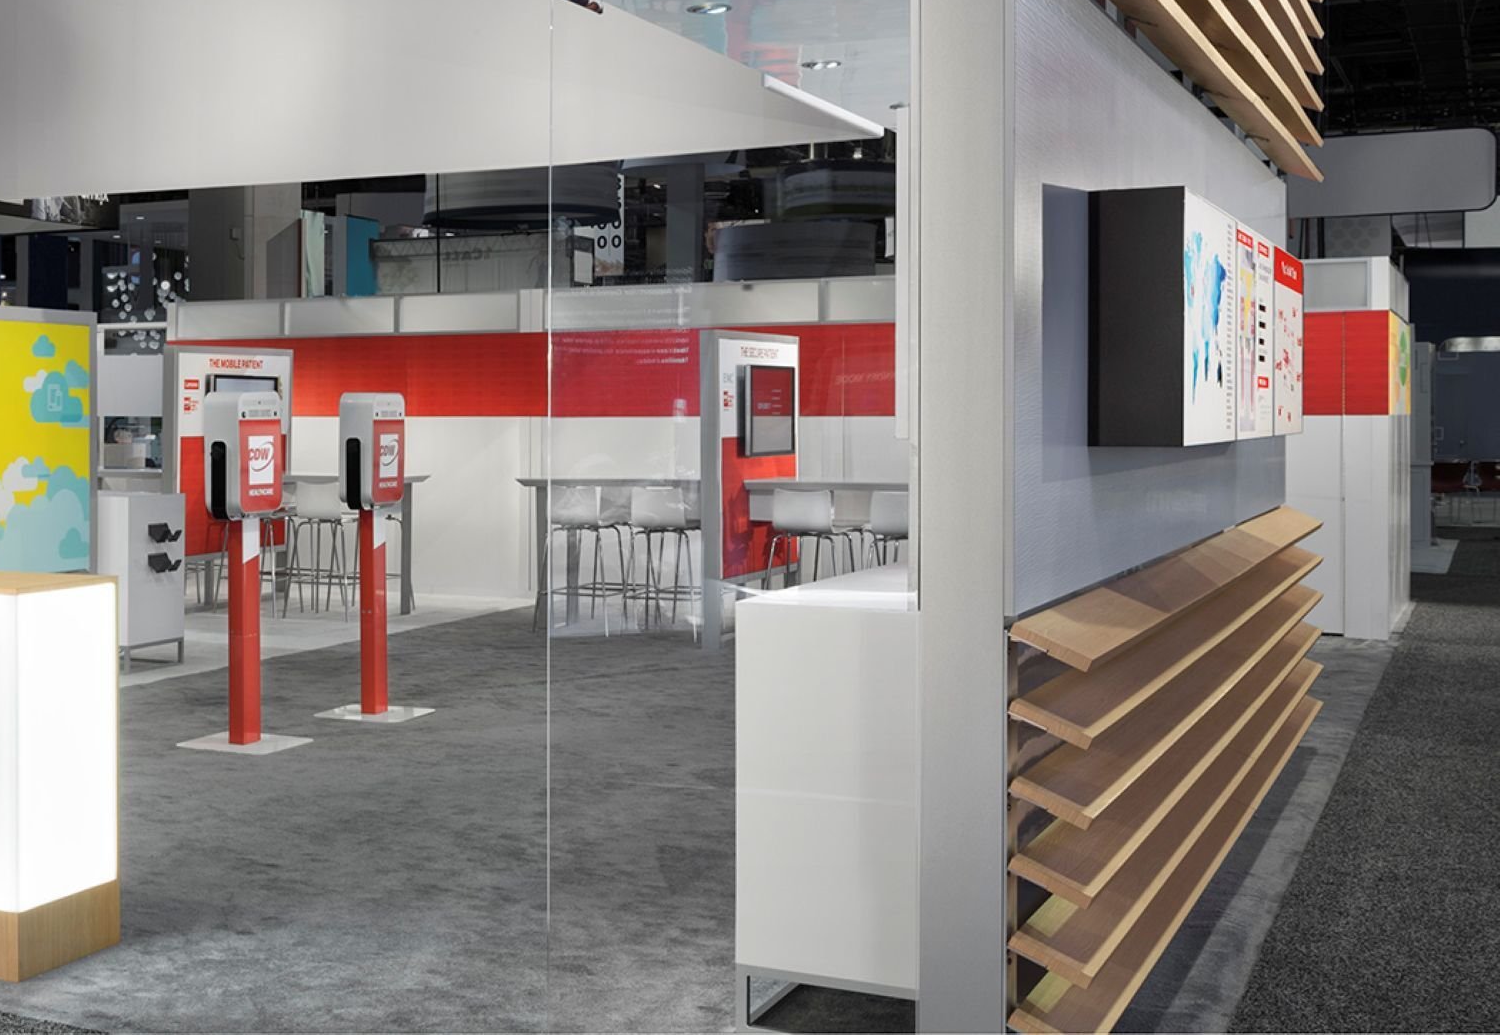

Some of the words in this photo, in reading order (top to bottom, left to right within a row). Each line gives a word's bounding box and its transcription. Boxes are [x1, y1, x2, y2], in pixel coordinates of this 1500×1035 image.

[209, 358, 220, 368] THE
[220, 358, 241, 369] MOBILE
[242, 359, 264, 370] PATIENT
[249, 447, 270, 461] CDW
[380, 445, 396, 456] CDW
